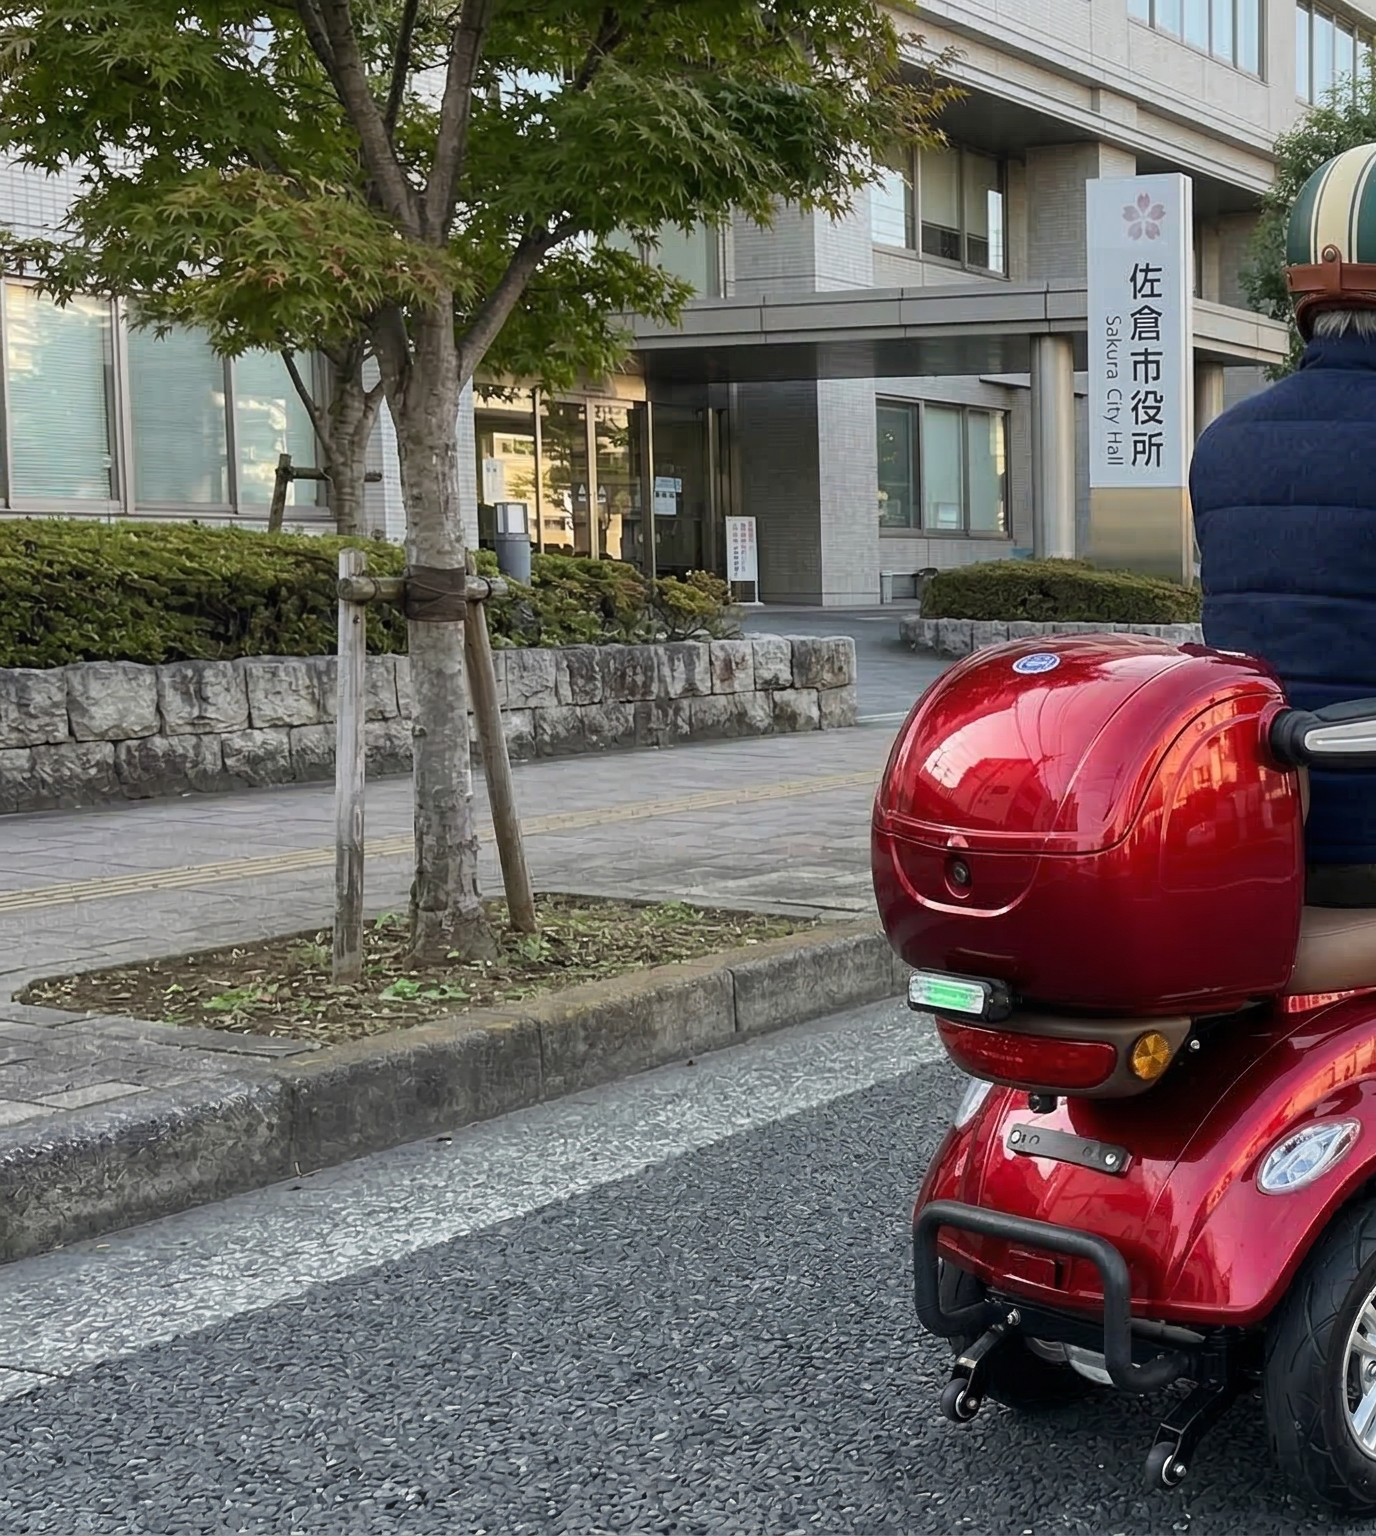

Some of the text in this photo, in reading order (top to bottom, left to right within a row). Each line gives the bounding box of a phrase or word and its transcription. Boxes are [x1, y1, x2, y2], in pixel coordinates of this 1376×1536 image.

[1103, 315, 1124, 466] Sakura City Hall
[1129, 262, 1164, 468] 佐倉市役所
